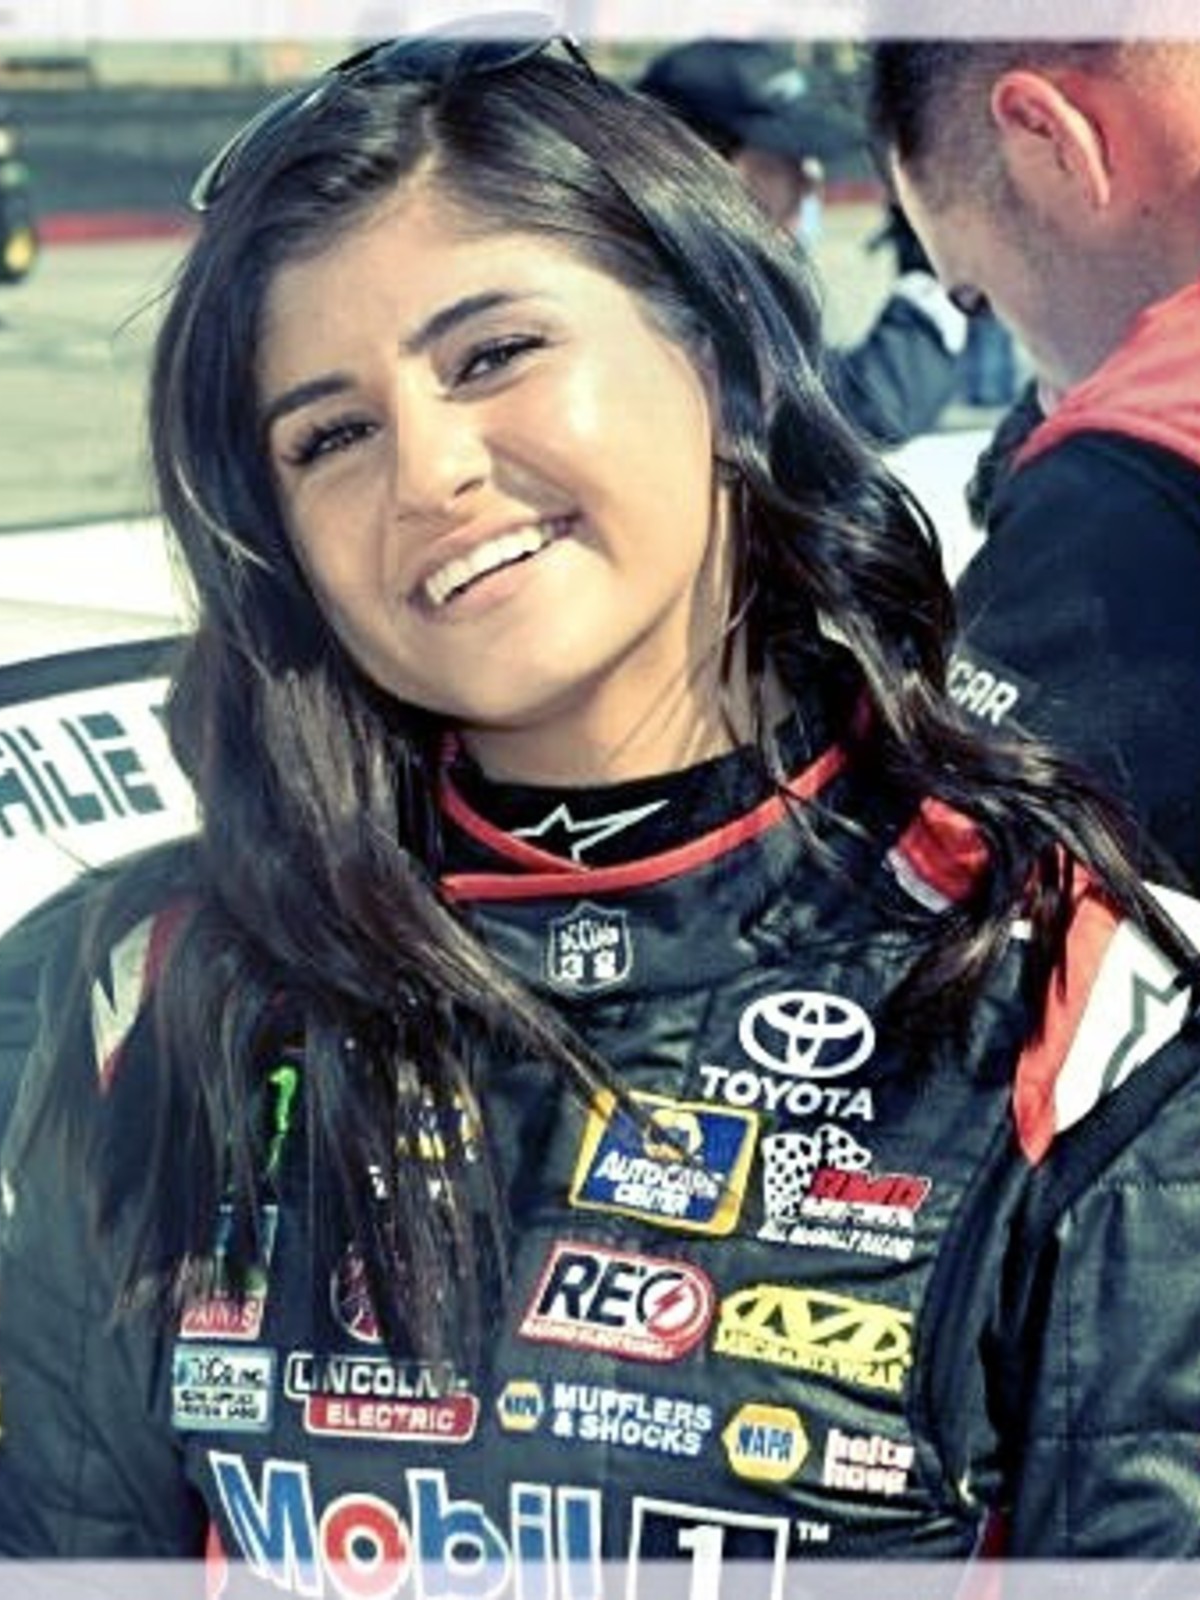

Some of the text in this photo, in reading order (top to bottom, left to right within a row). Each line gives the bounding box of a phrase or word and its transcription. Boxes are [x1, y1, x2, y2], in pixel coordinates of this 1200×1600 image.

[945, 661, 1019, 727] CAR
[699, 1064, 874, 1122] TOYOTA
[326, 1401, 455, 1432] ELECTRIC
[553, 1384, 712, 1431] MUFFLERS
[553, 1411, 701, 1456] & SHOCKS
[208, 1451, 602, 1600] Mobil
